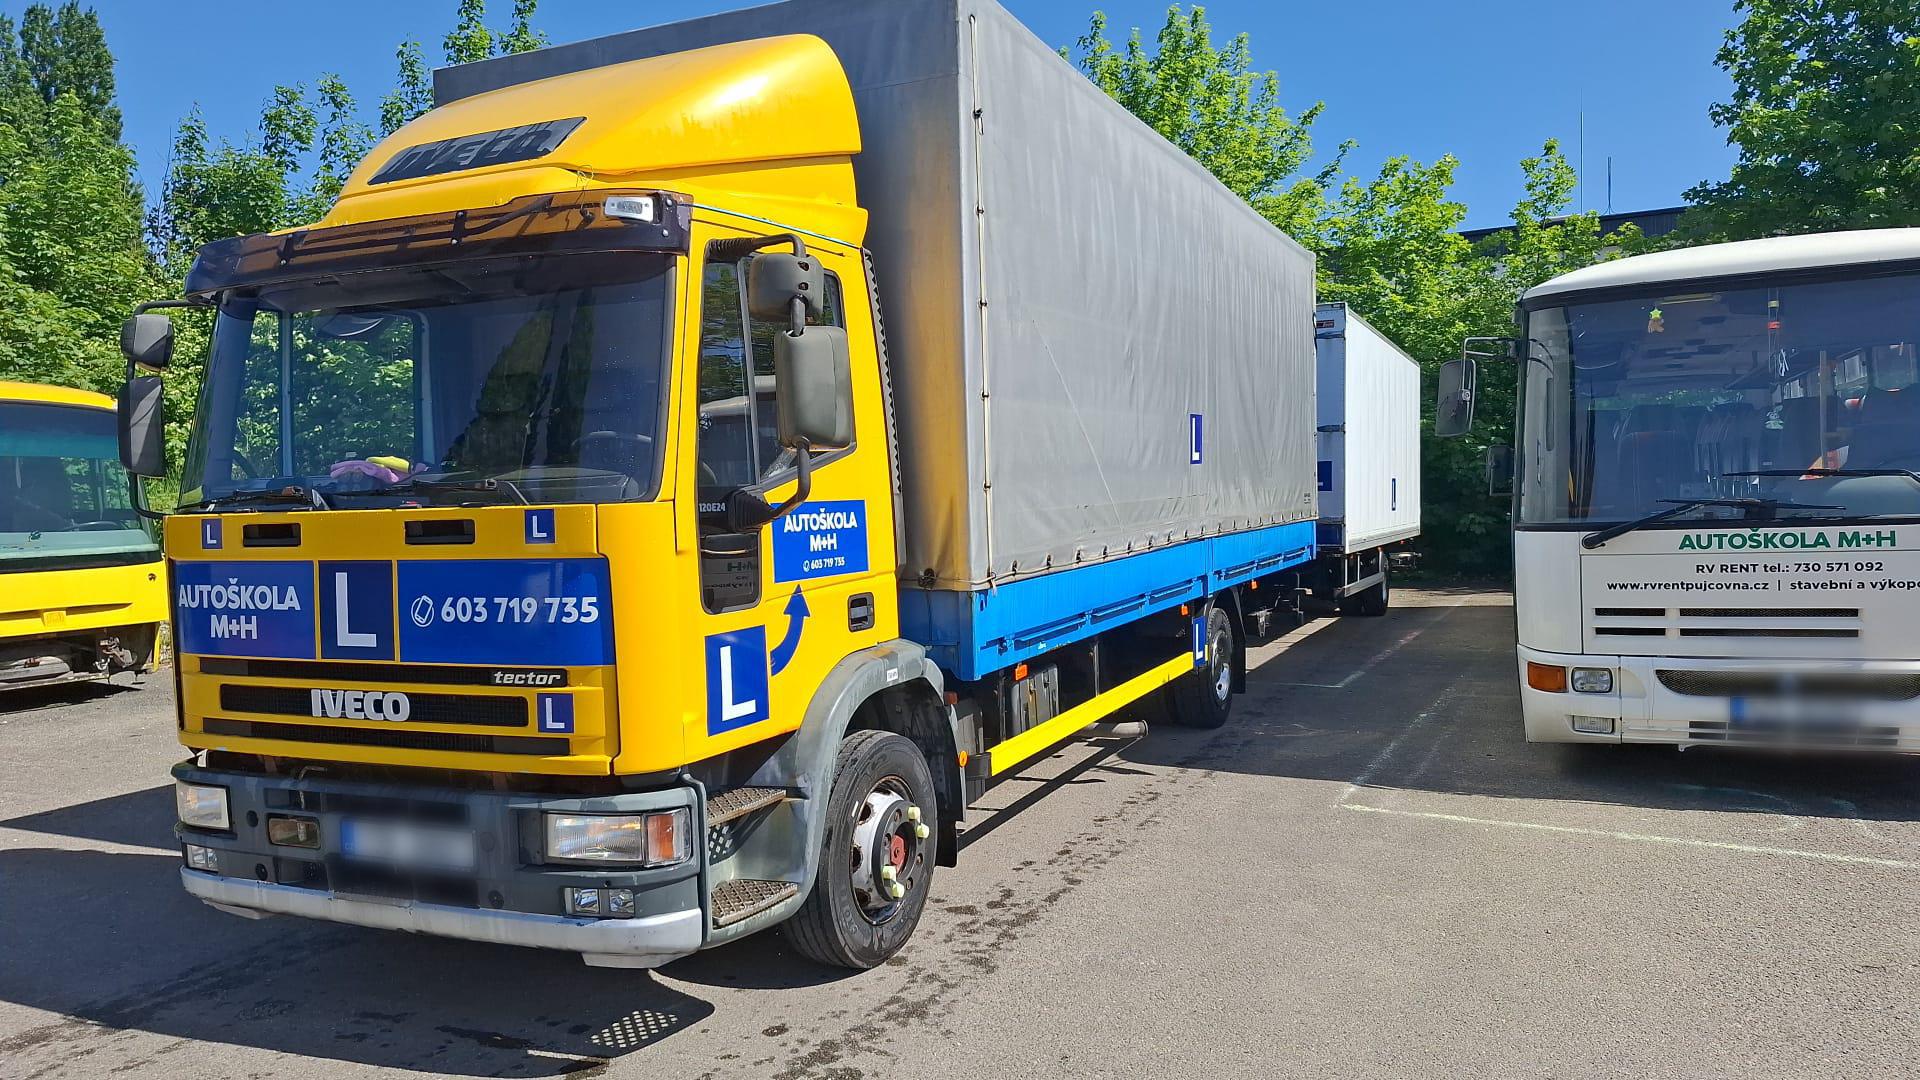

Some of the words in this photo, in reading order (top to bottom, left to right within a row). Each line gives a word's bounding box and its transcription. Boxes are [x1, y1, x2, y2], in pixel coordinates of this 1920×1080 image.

[1192, 417, 1200, 461] L
[532, 515, 548, 538] L
[784, 507, 858, 533] AUTOŠKOLA
[206, 523, 217, 545] L
[809, 533, 838, 552] M+H
[1679, 528, 1831, 550] AUTOŠKOLA
[1838, 530, 1896, 548] M+H
[811, 559, 823, 570] 603
[824, 558, 834, 568] 719
[1695, 564, 1716, 574] RV
[1720, 563, 1759, 573] RENT
[1763, 563, 1790, 573] tel.:
[1794, 563, 1821, 573] 730
[1826, 562, 1850, 572] 571
[1854, 562, 1884, 572] 092
[178, 578, 301, 610] AUTOŠKOLA
[1607, 580, 1769, 592] www.rvrentpujcovna.cz
[1790, 579, 1853, 590] stavební
[1856, 581, 1865, 590] a
[335, 572, 378, 648] L
[441, 597, 488, 623] 603
[494, 597, 538, 623] 719
[545, 596, 599, 623] 735
[210, 614, 258, 639] M+H
[1195, 623, 1204, 661] L
[493, 671, 561, 686] tector
[719, 645, 757, 722] L
[311, 689, 410, 721] IVECO
[545, 698, 566, 730] L
